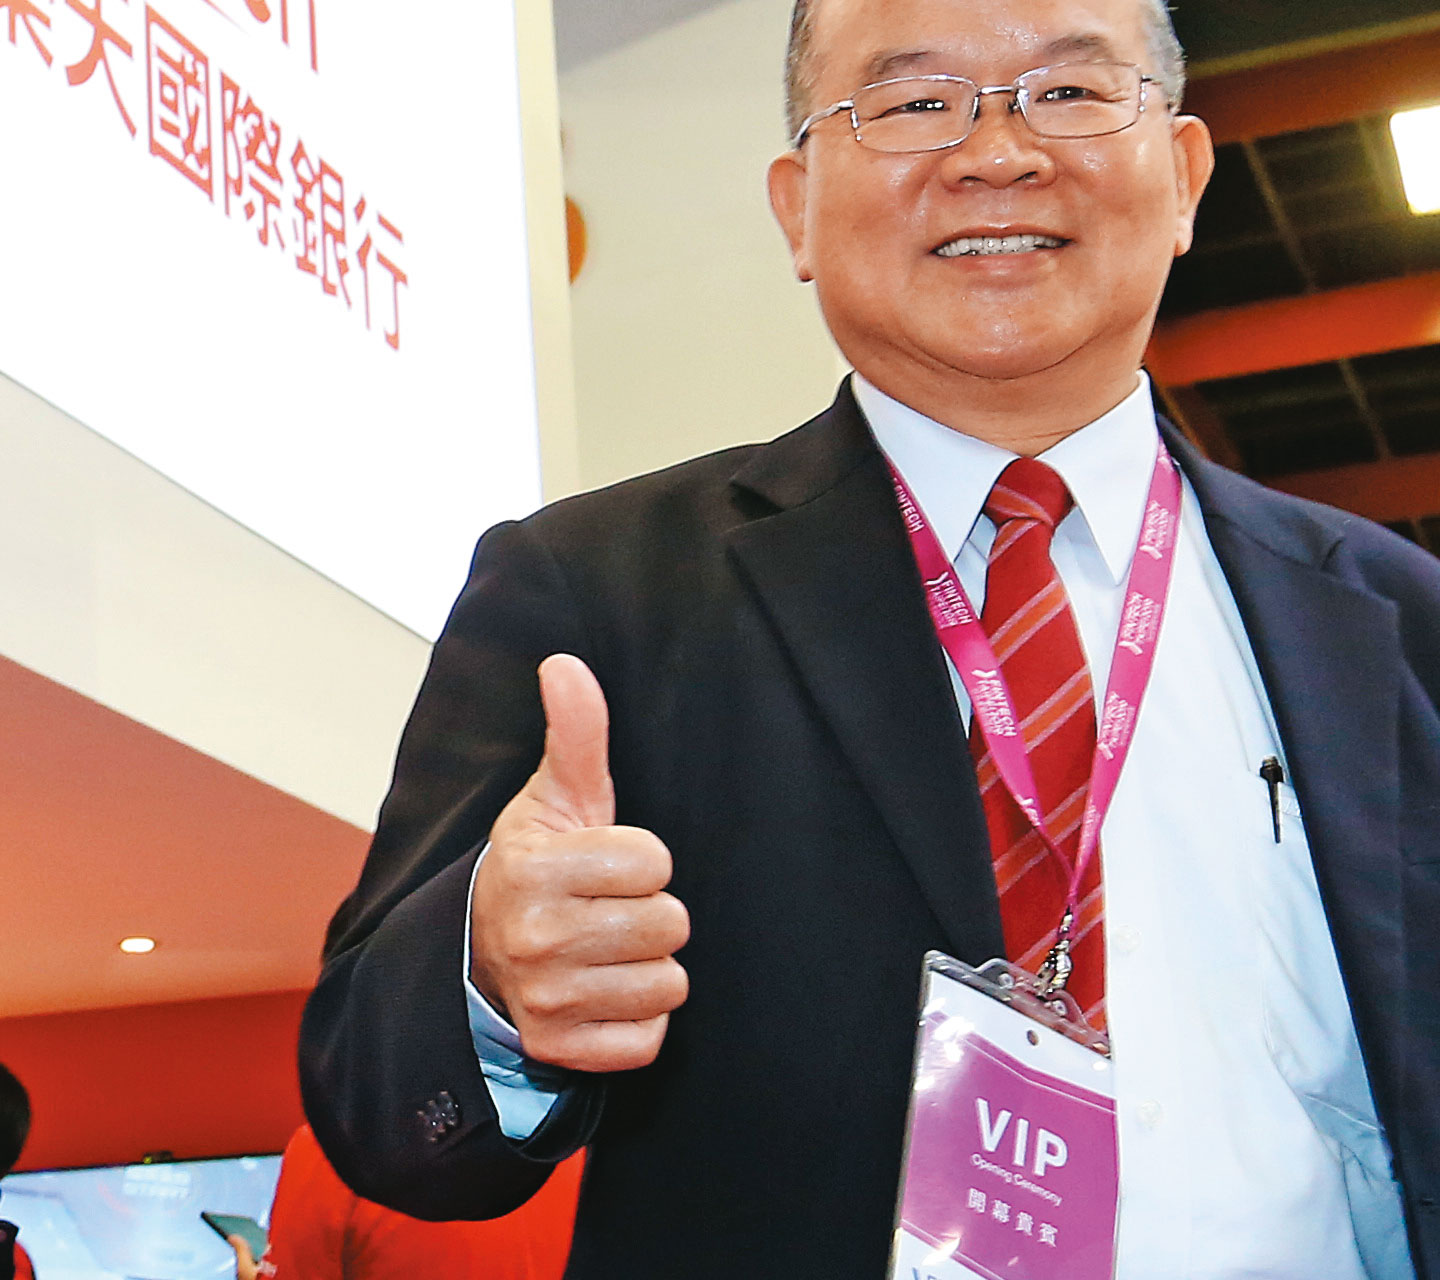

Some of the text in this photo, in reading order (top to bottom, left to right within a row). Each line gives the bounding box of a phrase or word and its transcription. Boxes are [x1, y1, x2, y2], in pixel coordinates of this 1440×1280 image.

[940, 579, 972, 624] FINTECH
[986, 680, 1017, 736] FINTECH
[976, 1095, 1069, 1178] VIP
[970, 1152, 1063, 1207] Opening Ceremony
